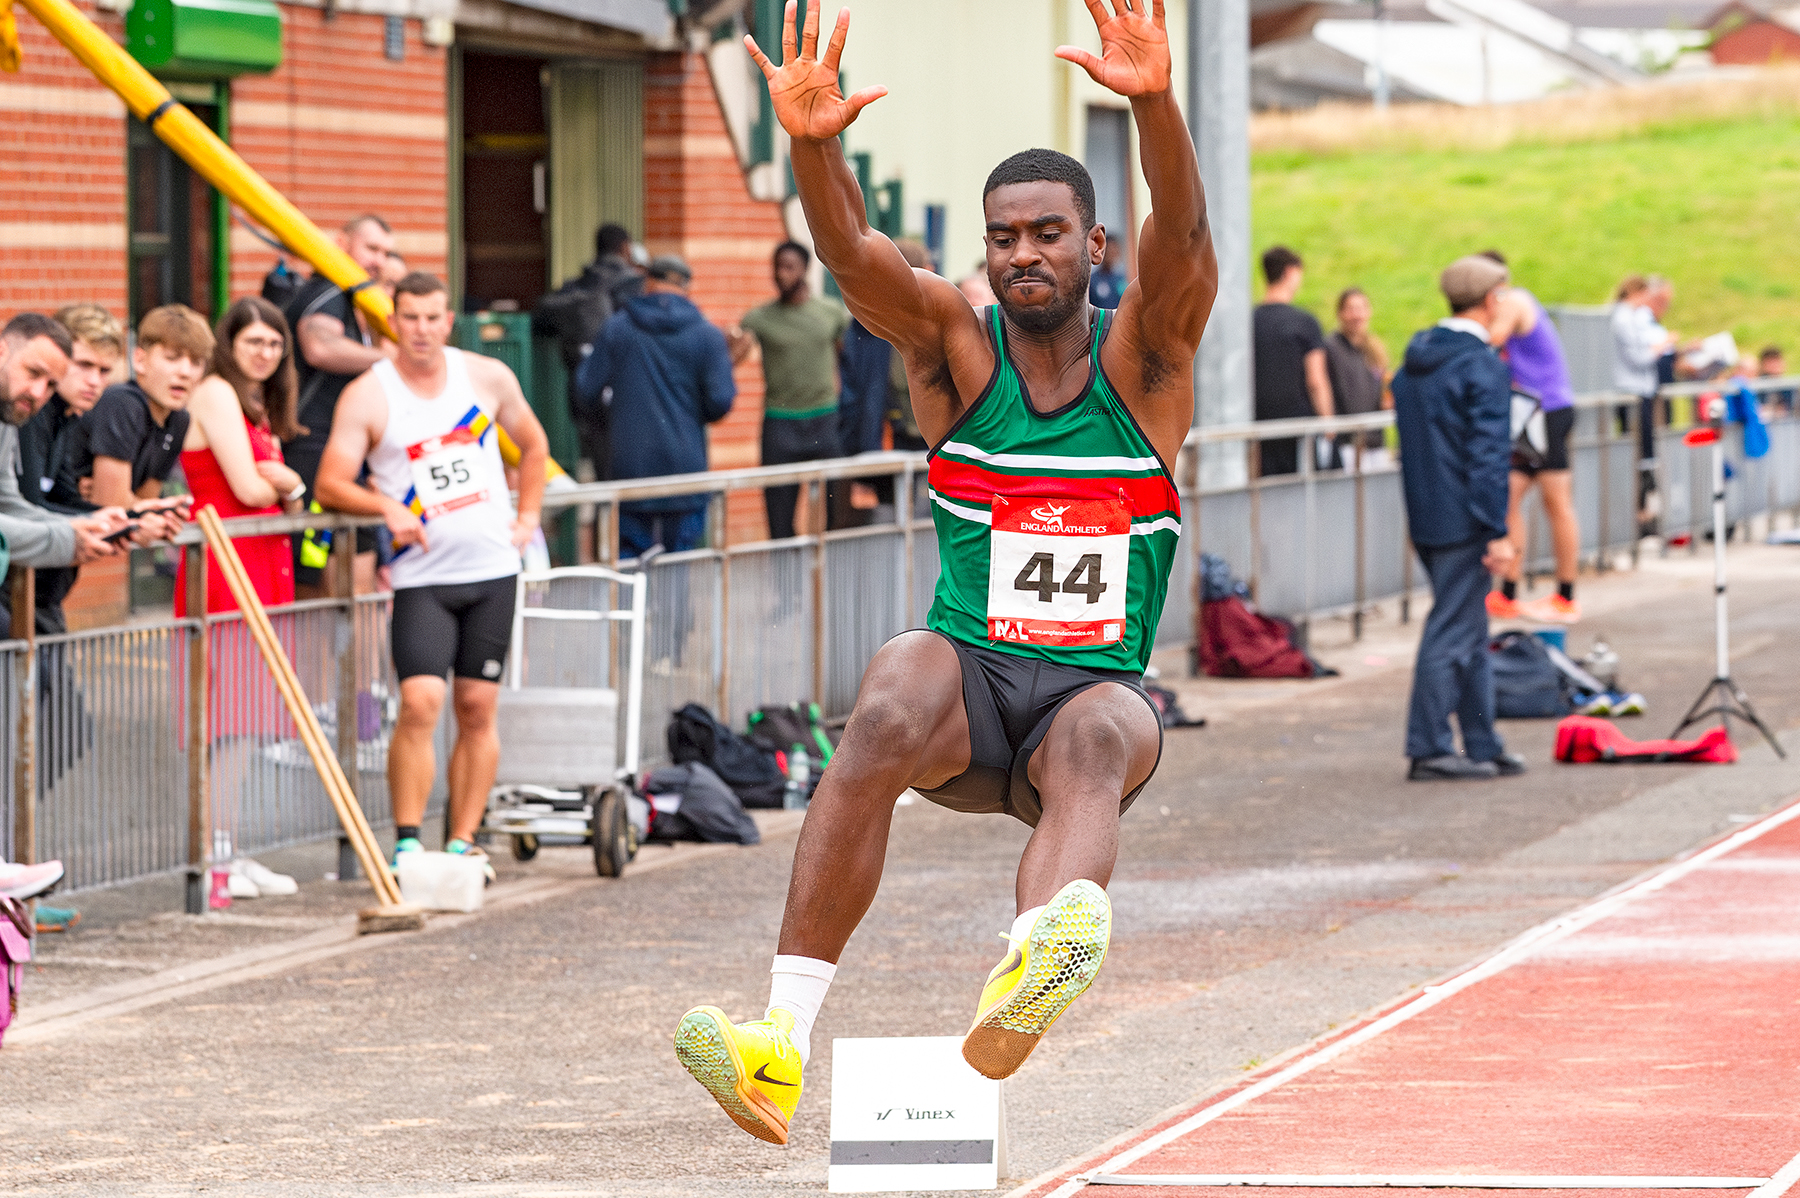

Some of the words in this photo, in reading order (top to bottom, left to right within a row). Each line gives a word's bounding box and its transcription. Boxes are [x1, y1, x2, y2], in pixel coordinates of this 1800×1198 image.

[429, 459, 470, 490] 55
[1020, 522, 1060, 533] ENGLAND
[1063, 525, 1107, 534] ATHLETICS
[1014, 551, 1107, 604] 44
[1028, 628, 1096, 637] www.englandathletics.org
[905, 1107, 956, 1120] Vinex
